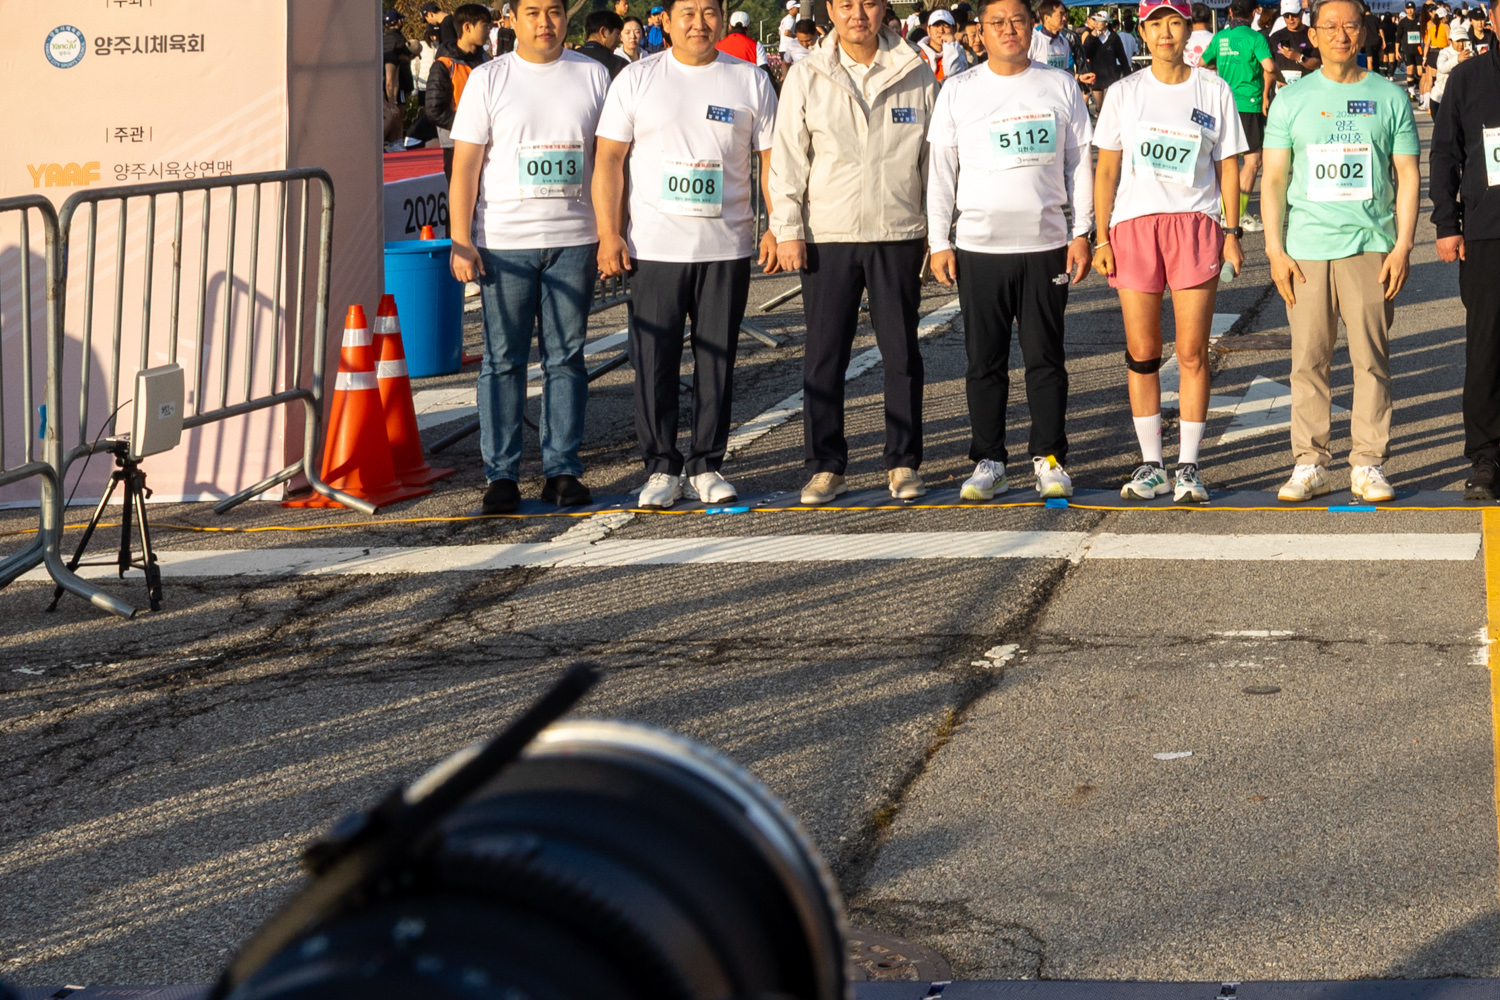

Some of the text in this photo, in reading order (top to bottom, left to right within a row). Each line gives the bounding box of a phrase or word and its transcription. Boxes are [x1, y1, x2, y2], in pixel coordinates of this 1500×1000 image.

[94, 33, 205, 56] 양주시체육회
[113, 126, 144, 143] 주관
[999, 128, 1050, 149] 5112
[1140, 141, 1191, 164] 0007
[113, 160, 233, 182] 양주시육상연맹
[527, 159, 577, 176] 0013
[1315, 163, 1364, 179] 0002
[668, 176, 715, 195] 0008
[403, 191, 449, 235] 2026
